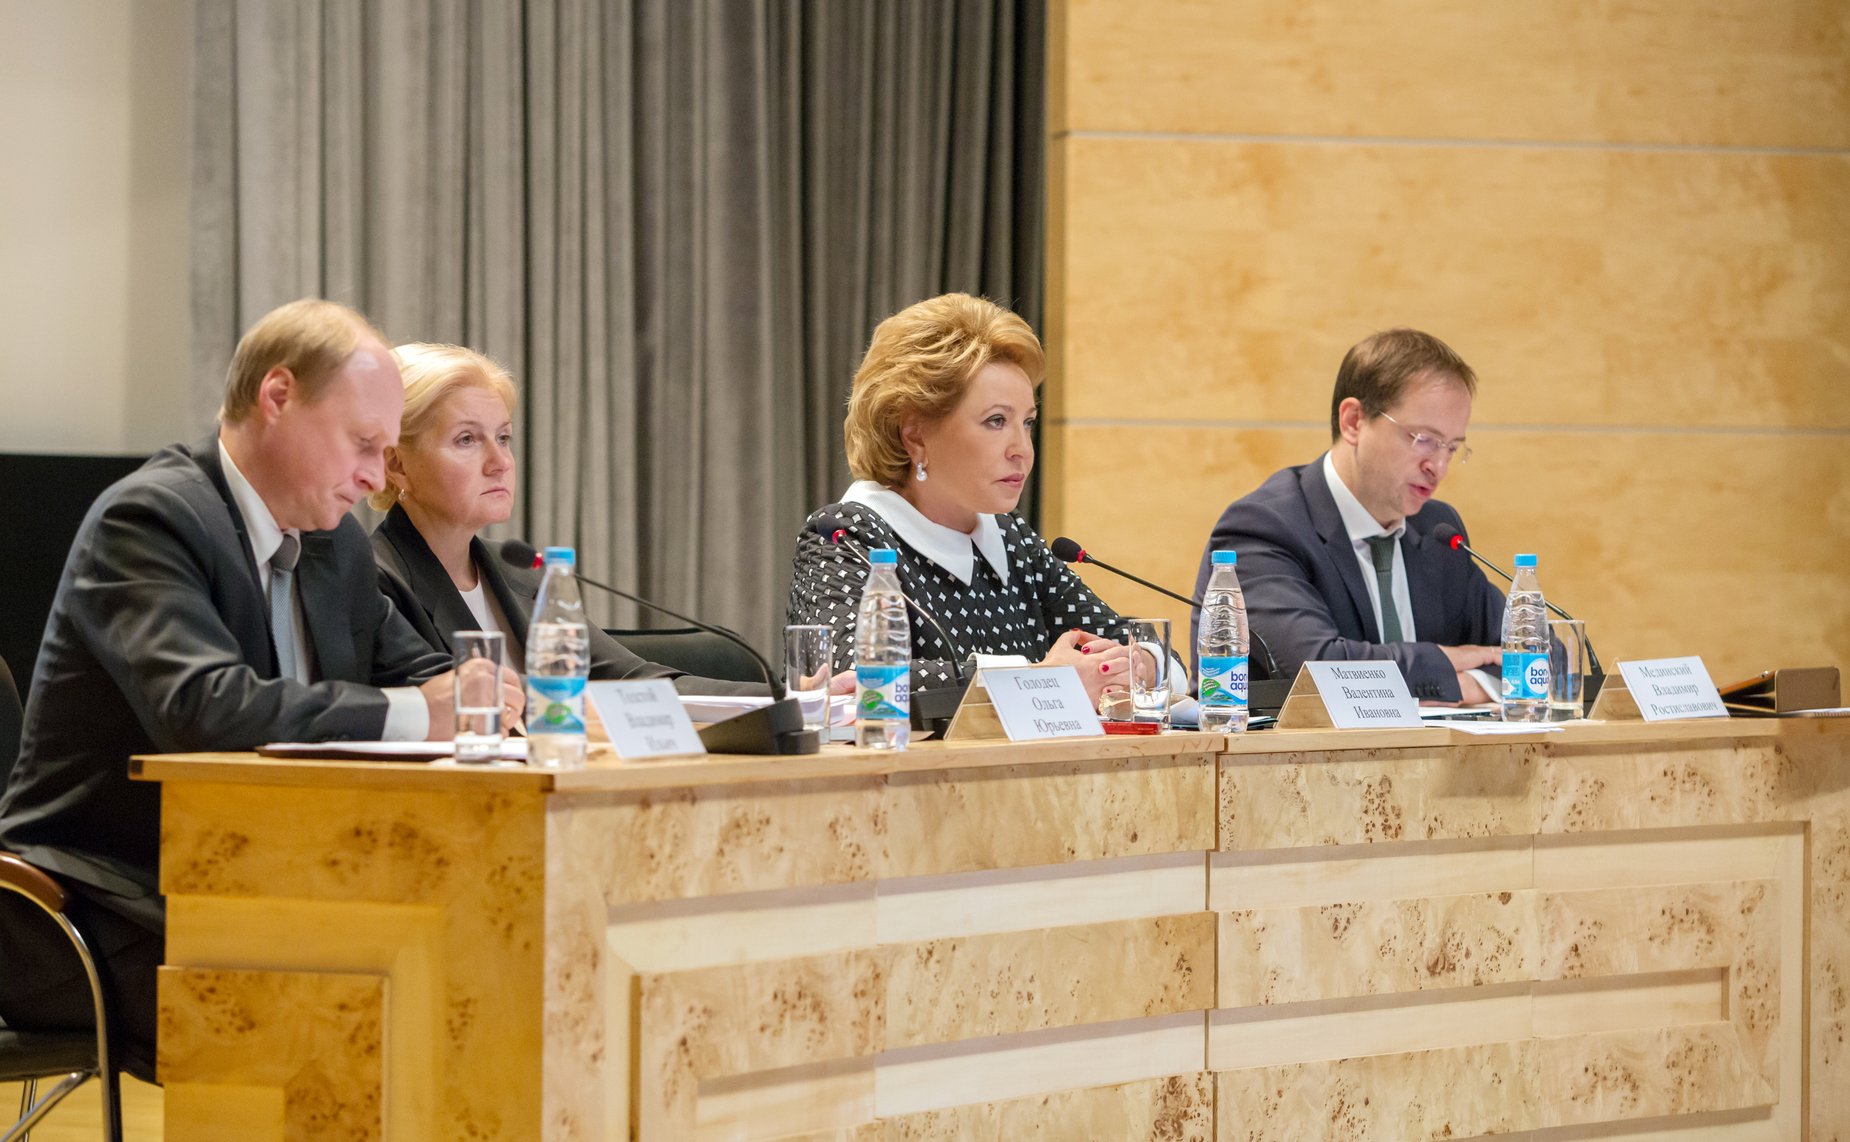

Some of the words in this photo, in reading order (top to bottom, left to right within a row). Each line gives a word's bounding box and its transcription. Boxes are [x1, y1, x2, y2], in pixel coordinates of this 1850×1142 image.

[1330, 666, 1387, 680] Матвиенко
[1638, 664, 1692, 679] Мединский
[1014, 676, 1061, 691] Голодец
[1652, 683, 1699, 697] Владимир
[1341, 686, 1395, 699] Валентина
[1032, 696, 1065, 711] Ольга
[1651, 701, 1719, 716] Ростиславович
[1353, 705, 1402, 719] Ивановна
[1033, 718, 1083, 735] Юрьевна
